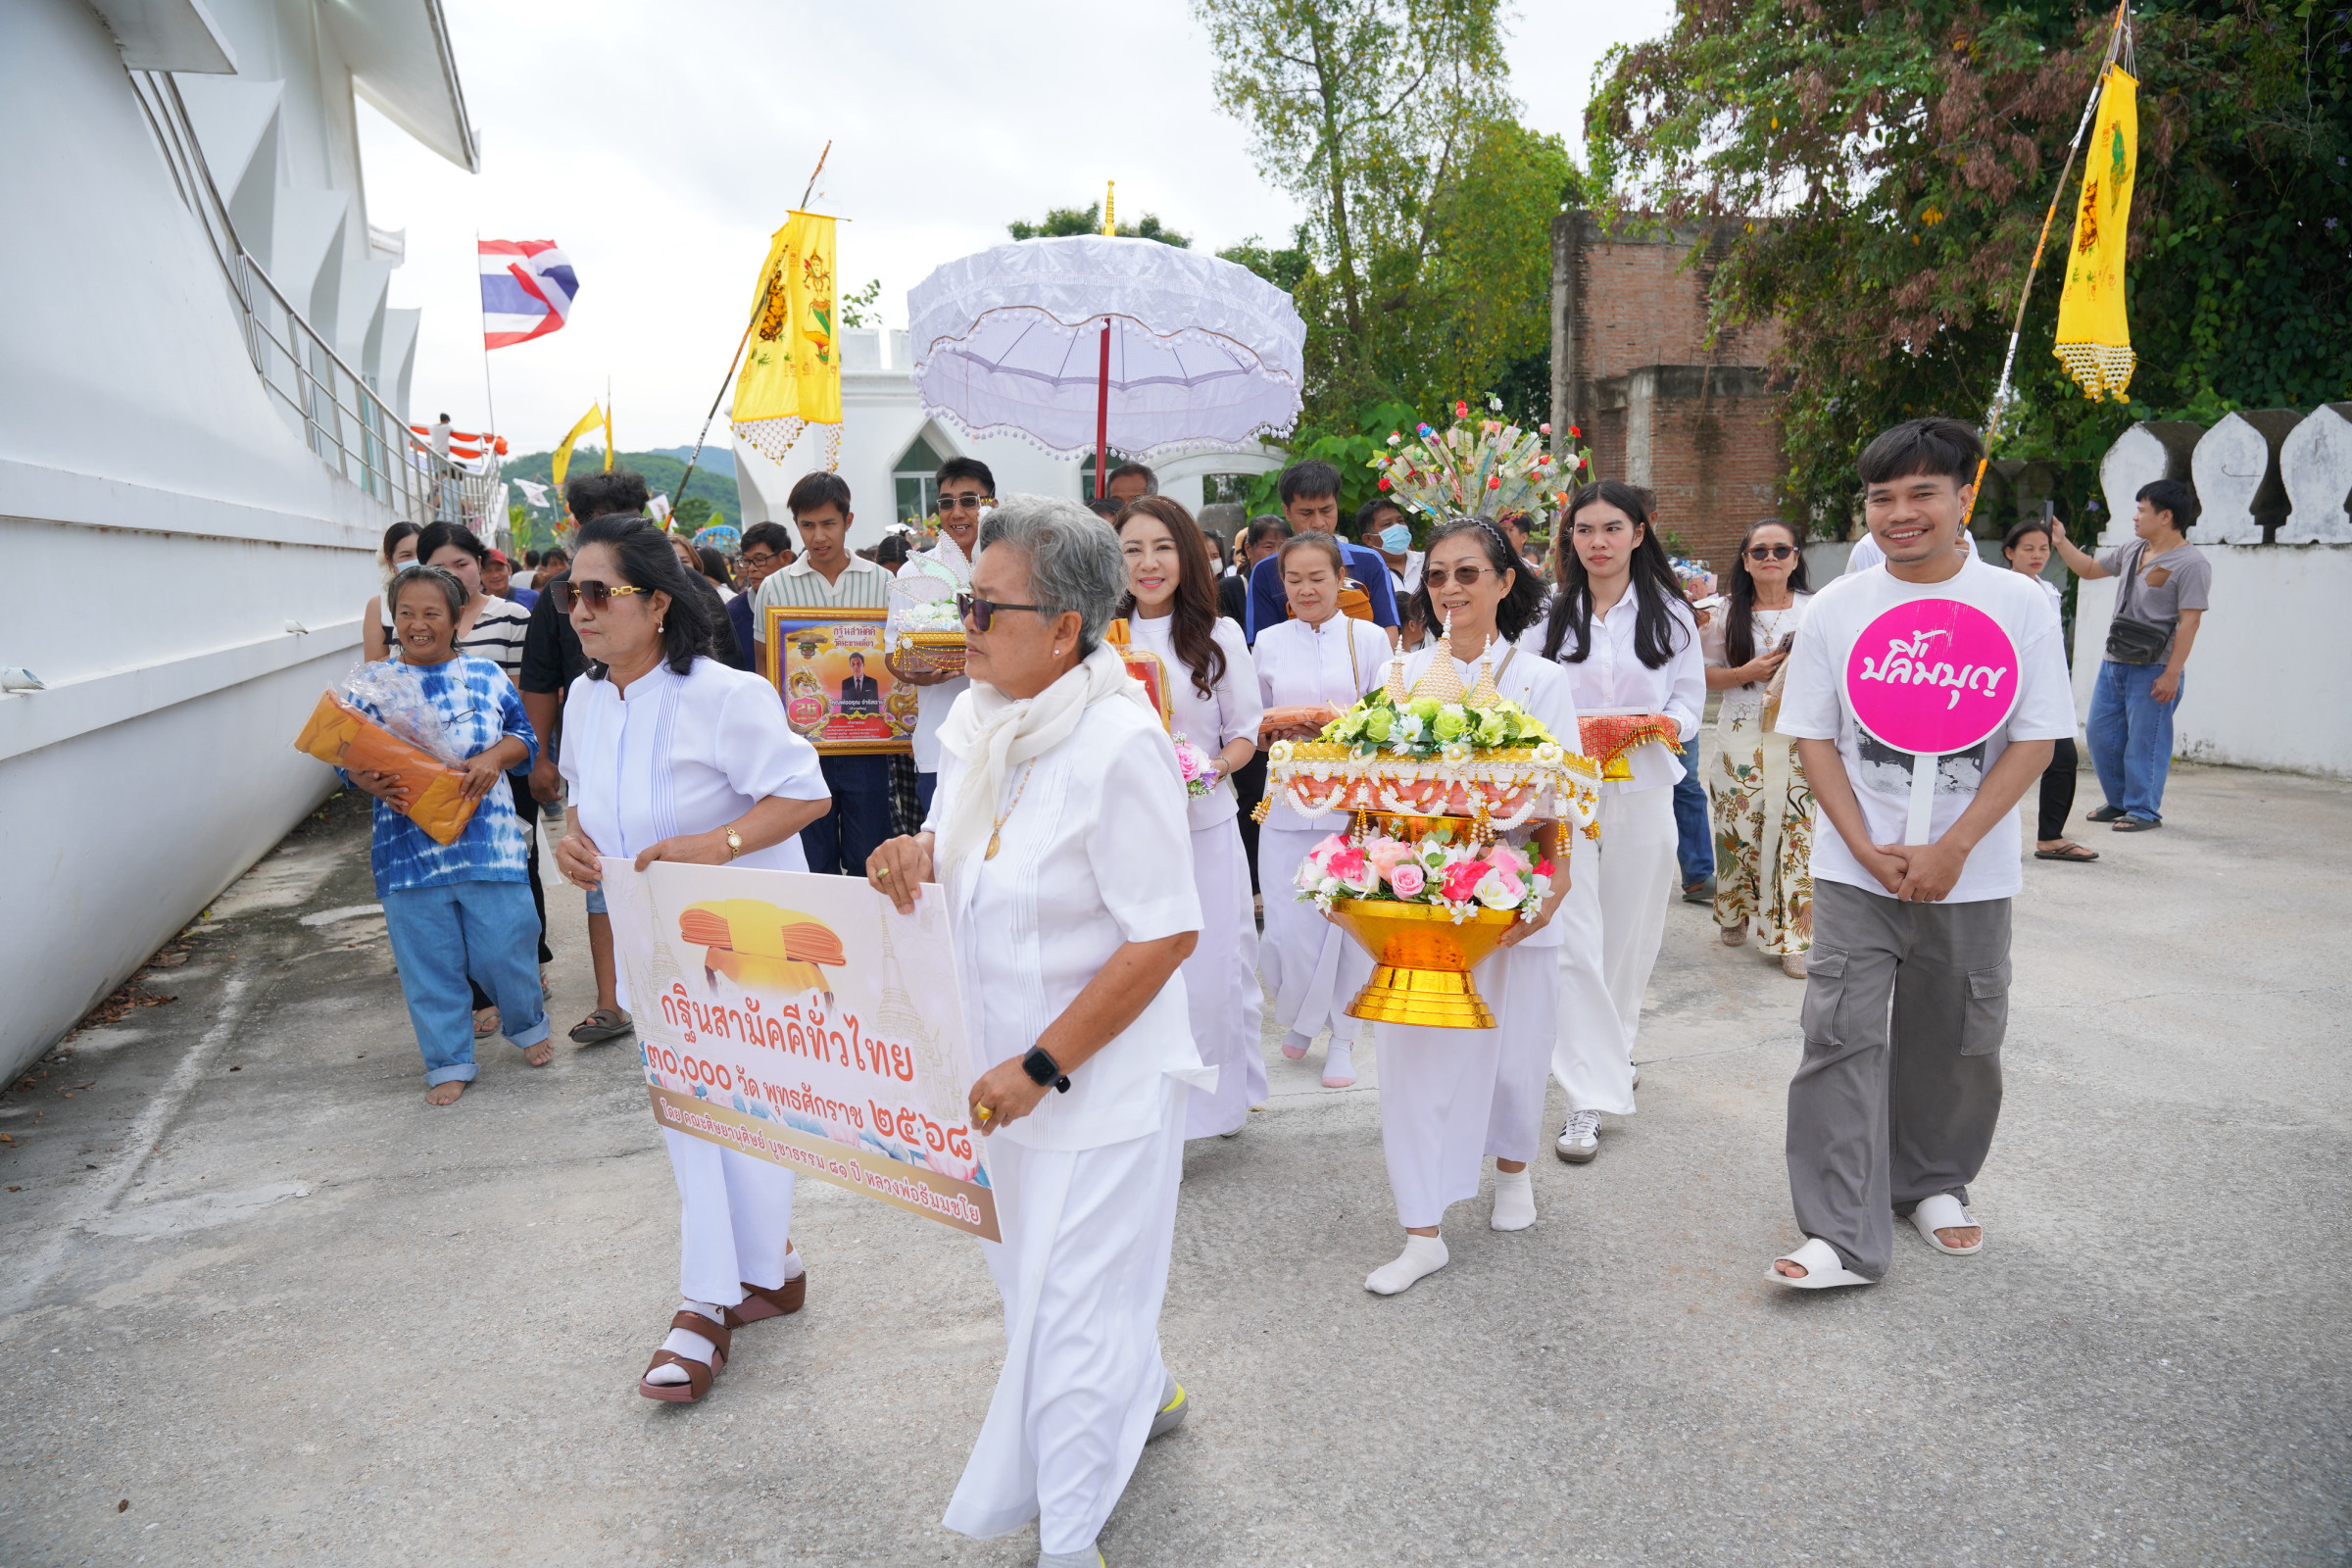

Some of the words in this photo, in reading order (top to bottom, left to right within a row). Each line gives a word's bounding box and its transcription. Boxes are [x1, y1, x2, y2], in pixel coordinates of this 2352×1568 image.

[796, 702, 817, 715] 26
[1860, 629, 2007, 710] ปลื้มบุญ
[661, 982, 913, 1082] กฐินสามัคคีทั่วไทย
[647, 1044, 732, 1091] ๓๐,๐๐๐
[736, 1064, 760, 1100] วัด
[763, 1083, 864, 1130] พุทธศักราช
[869, 1099, 973, 1161] ๒๕๖๘
[661, 1098, 681, 1122] โดย
[684, 1113, 765, 1151] คณะศิษยานุศิษย์
[768, 1139, 825, 1170] บูชาธรรม
[850, 1158, 861, 1182] ปี
[864, 1171, 980, 1223] หลวงพ่อธัมมชโย
